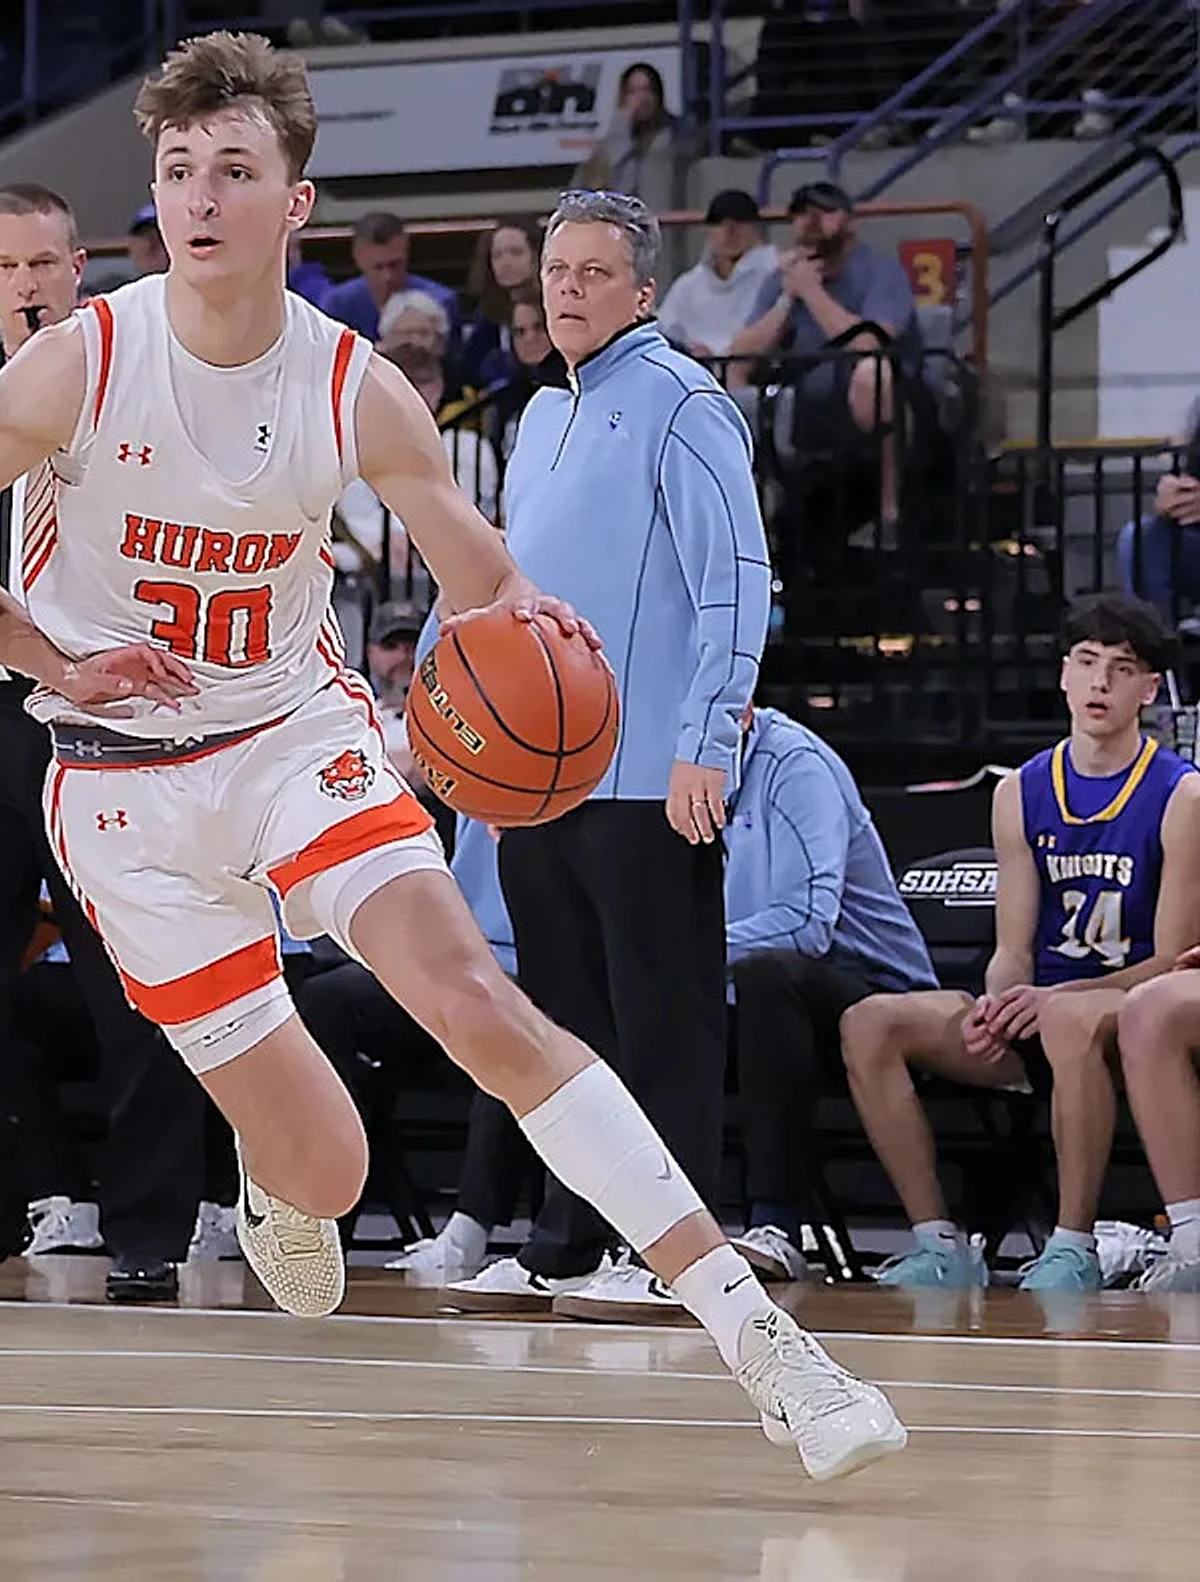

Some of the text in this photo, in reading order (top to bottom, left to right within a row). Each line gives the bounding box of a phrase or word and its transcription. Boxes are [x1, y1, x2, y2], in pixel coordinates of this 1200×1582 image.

[912, 253, 945, 307] 3
[120, 513, 304, 574] HURON
[133, 579, 273, 669] 30
[898, 869, 998, 893] SDHSA
